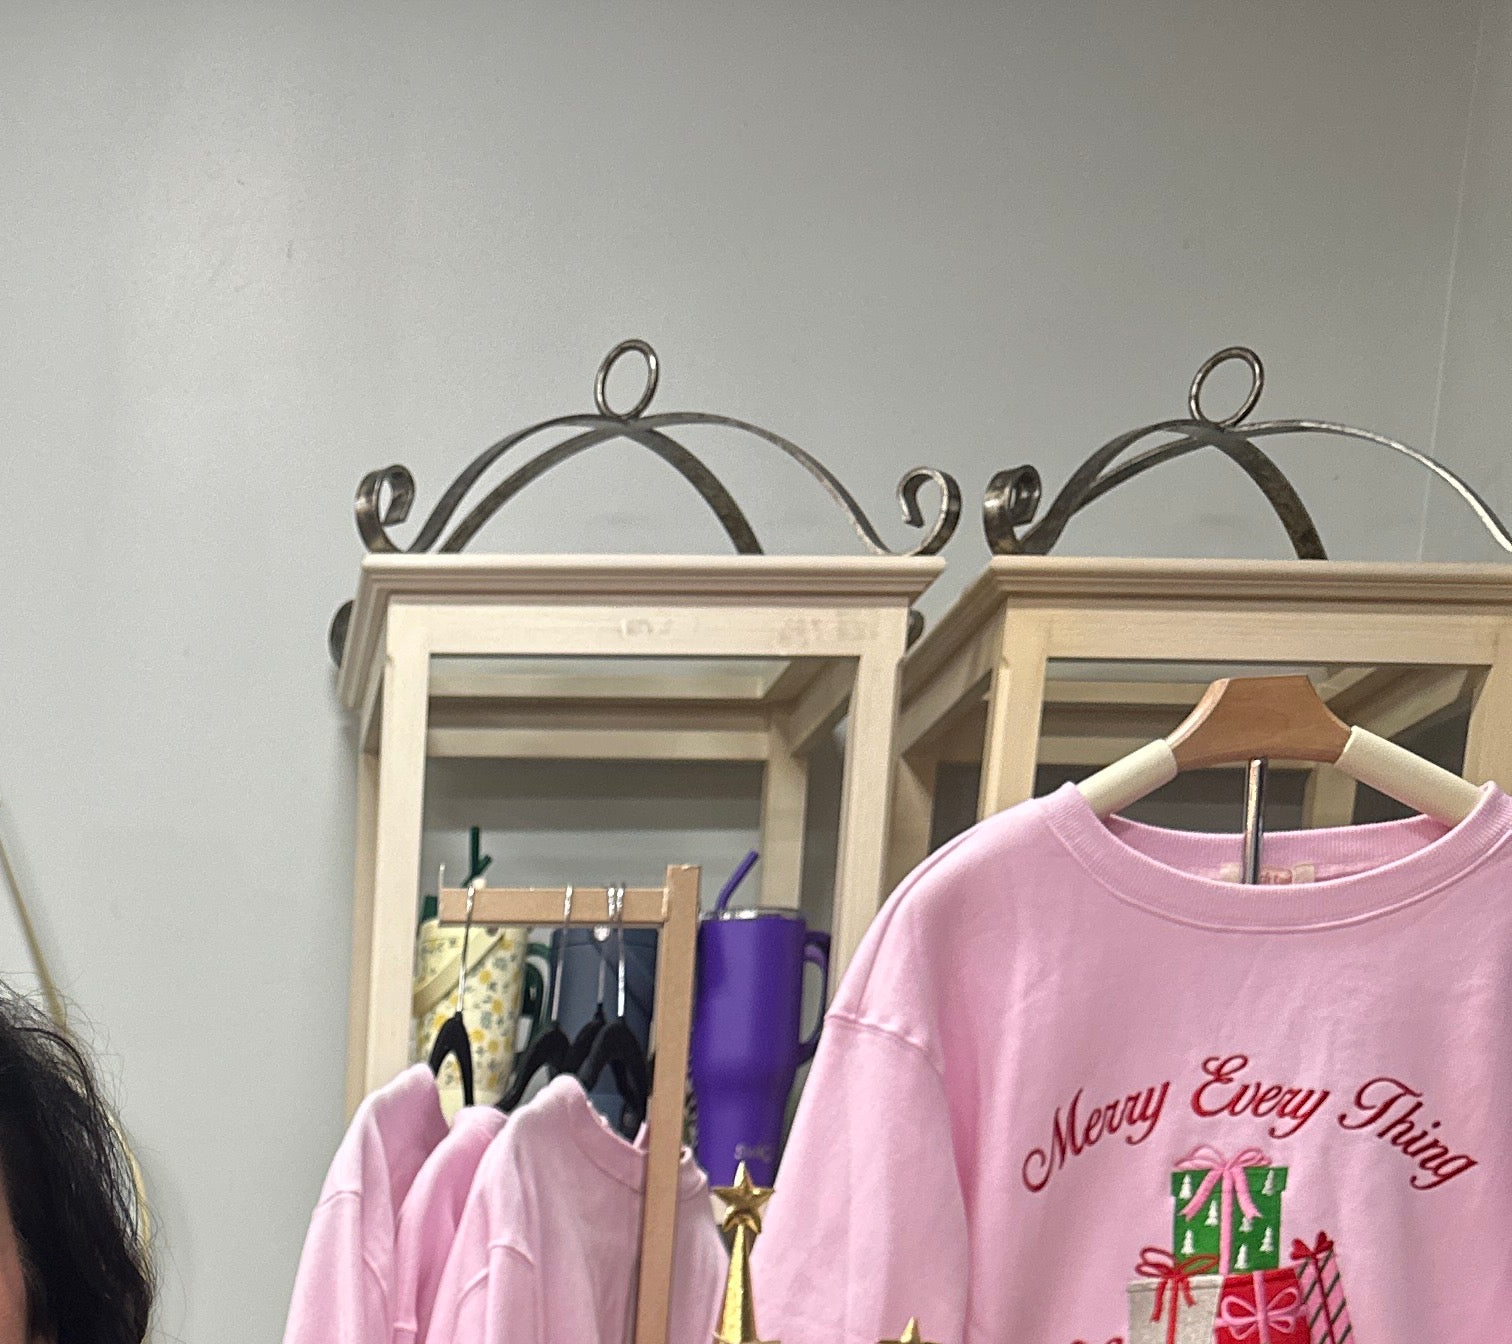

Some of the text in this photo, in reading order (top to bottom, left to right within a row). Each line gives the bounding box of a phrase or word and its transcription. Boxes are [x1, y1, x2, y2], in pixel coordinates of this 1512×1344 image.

[1022, 1055, 1478, 1192] Merry Every Thing
